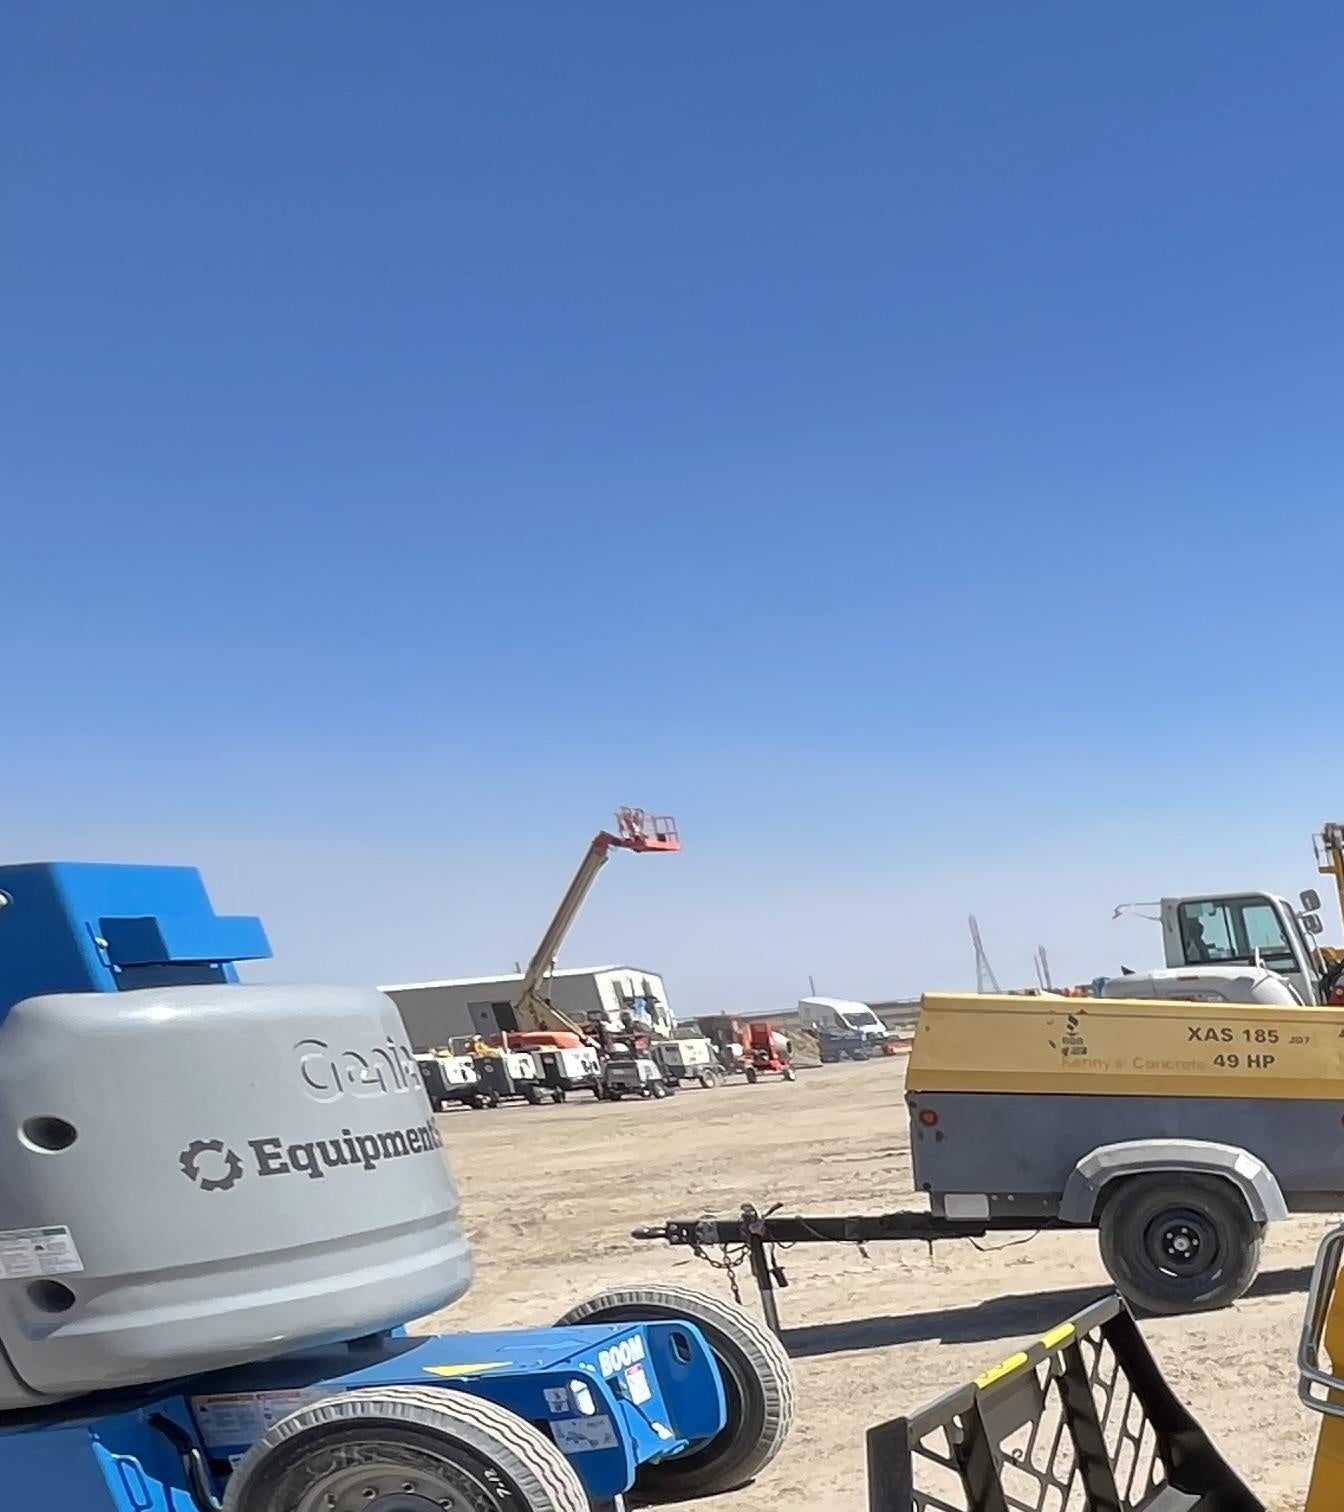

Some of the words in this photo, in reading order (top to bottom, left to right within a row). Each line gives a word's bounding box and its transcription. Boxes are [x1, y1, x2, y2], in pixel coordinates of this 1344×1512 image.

[1187, 1026, 1233, 1043] XAS
[1243, 1028, 1279, 1044] 185
[1213, 1054, 1240, 1069] 49
[1247, 1054, 1275, 1069] HP
[598, 1334, 645, 1377] BOOM
